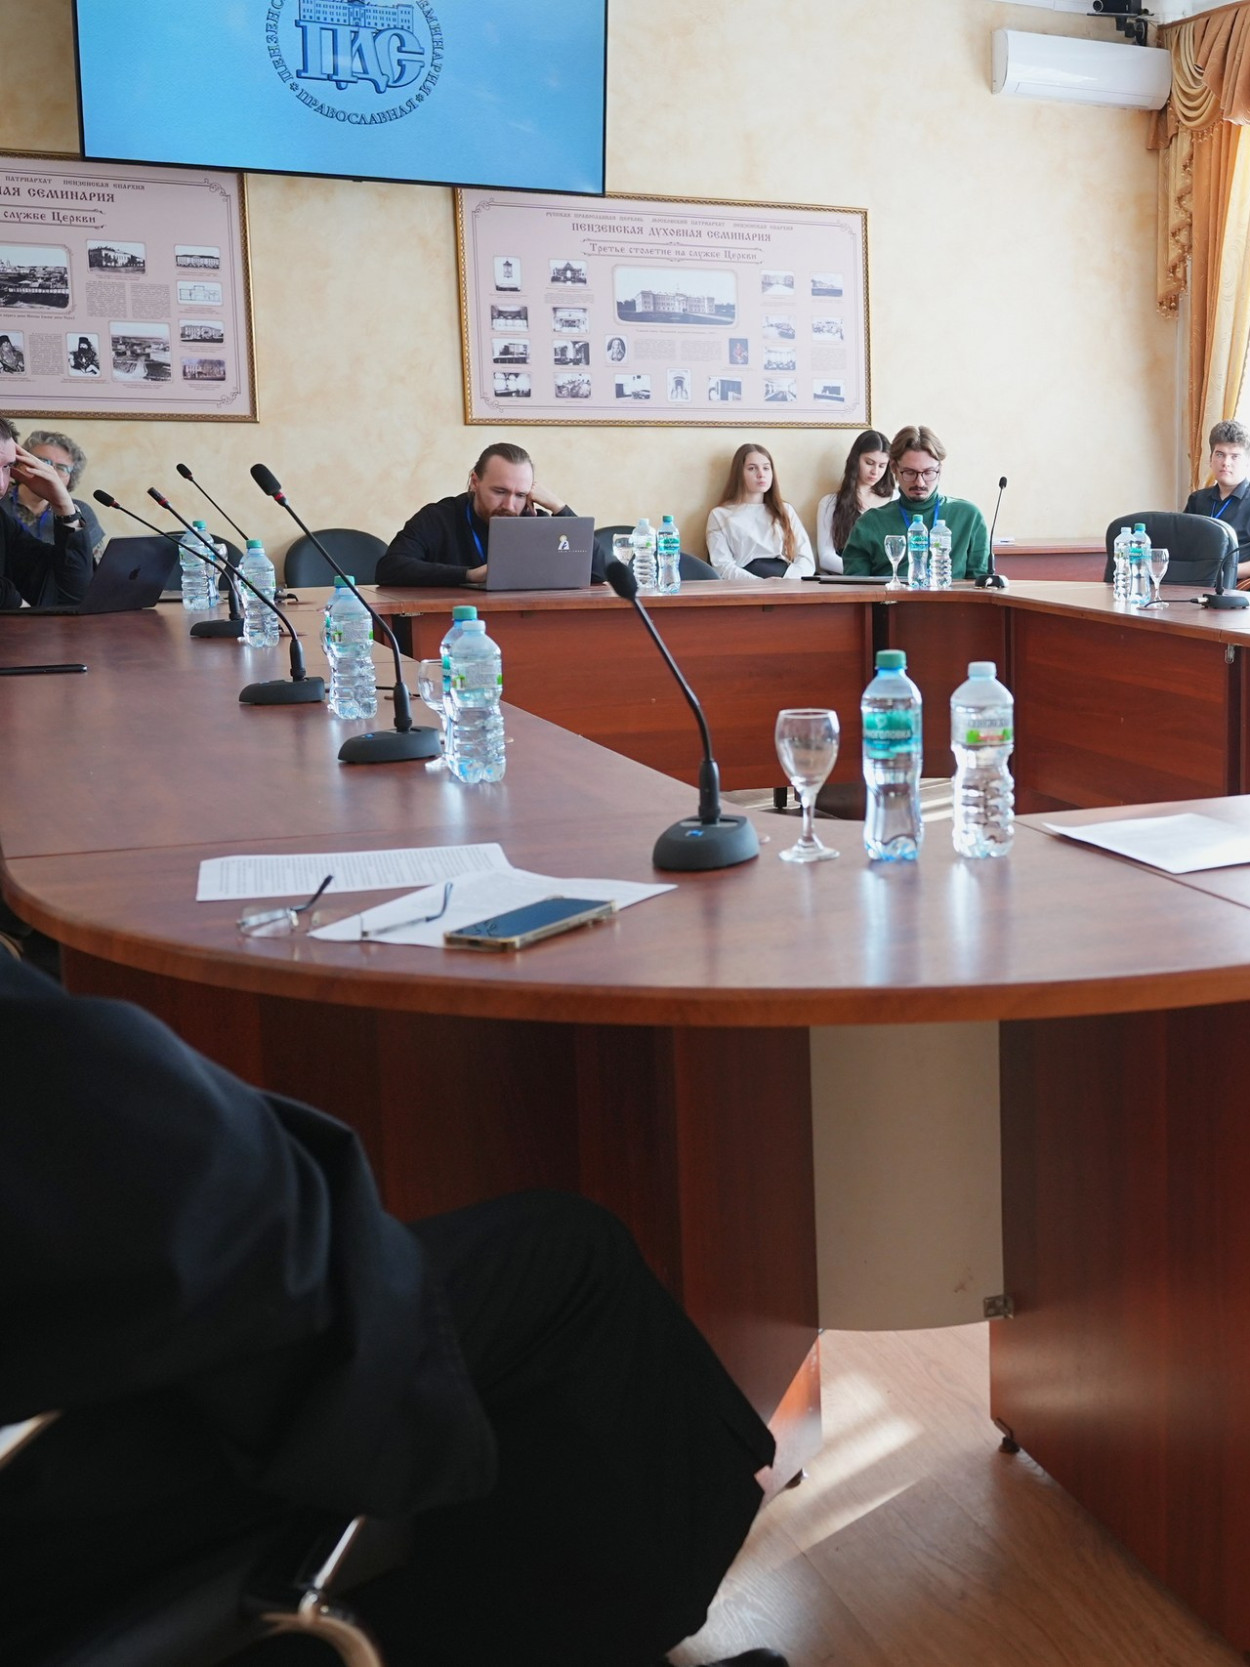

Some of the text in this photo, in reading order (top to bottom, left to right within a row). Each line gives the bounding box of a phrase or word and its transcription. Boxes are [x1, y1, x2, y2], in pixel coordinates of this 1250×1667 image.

[296, 88, 419, 125] ПРАВОСЛАВНАЯ
[5, 175, 53, 184] ПАТРИАРХАТ
[28, 188, 115, 203] СЕМИНАРИЯ
[4, 210, 96, 224] службе Церкви
[571, 222, 771, 242] ПЕНЗЕНСКАЯ ДУХОВНАЯ СЕМИНАРИЯ
[589, 242, 625, 254] Третье
[629, 247, 671, 256] столетие
[689, 250, 720, 259] службе
[724, 250, 757, 260] Церкви
